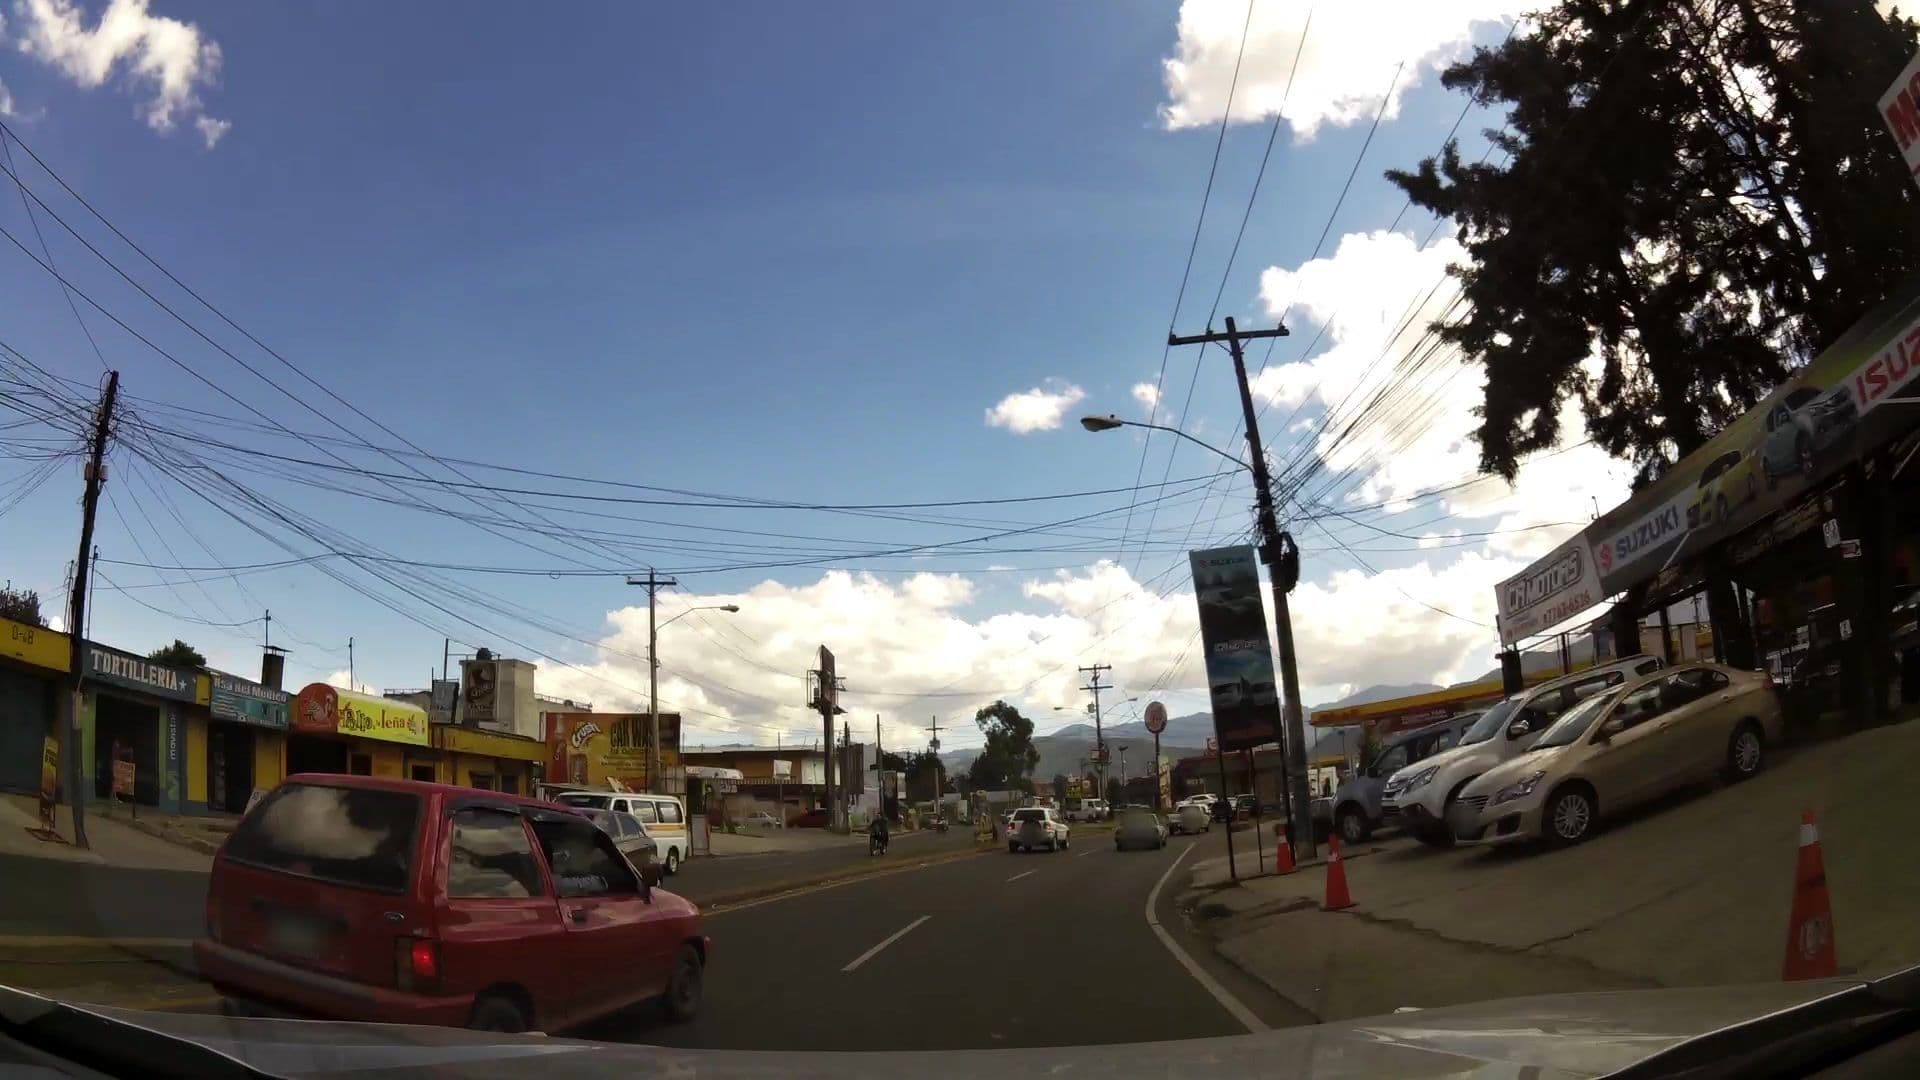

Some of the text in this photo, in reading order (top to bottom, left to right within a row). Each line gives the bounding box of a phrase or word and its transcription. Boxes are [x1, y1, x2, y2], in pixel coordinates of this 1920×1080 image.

[1616, 505, 1680, 559] SUZUKI
[91, 648, 178, 691] TORTILLERIA
[167, 712, 177, 760] movistar
